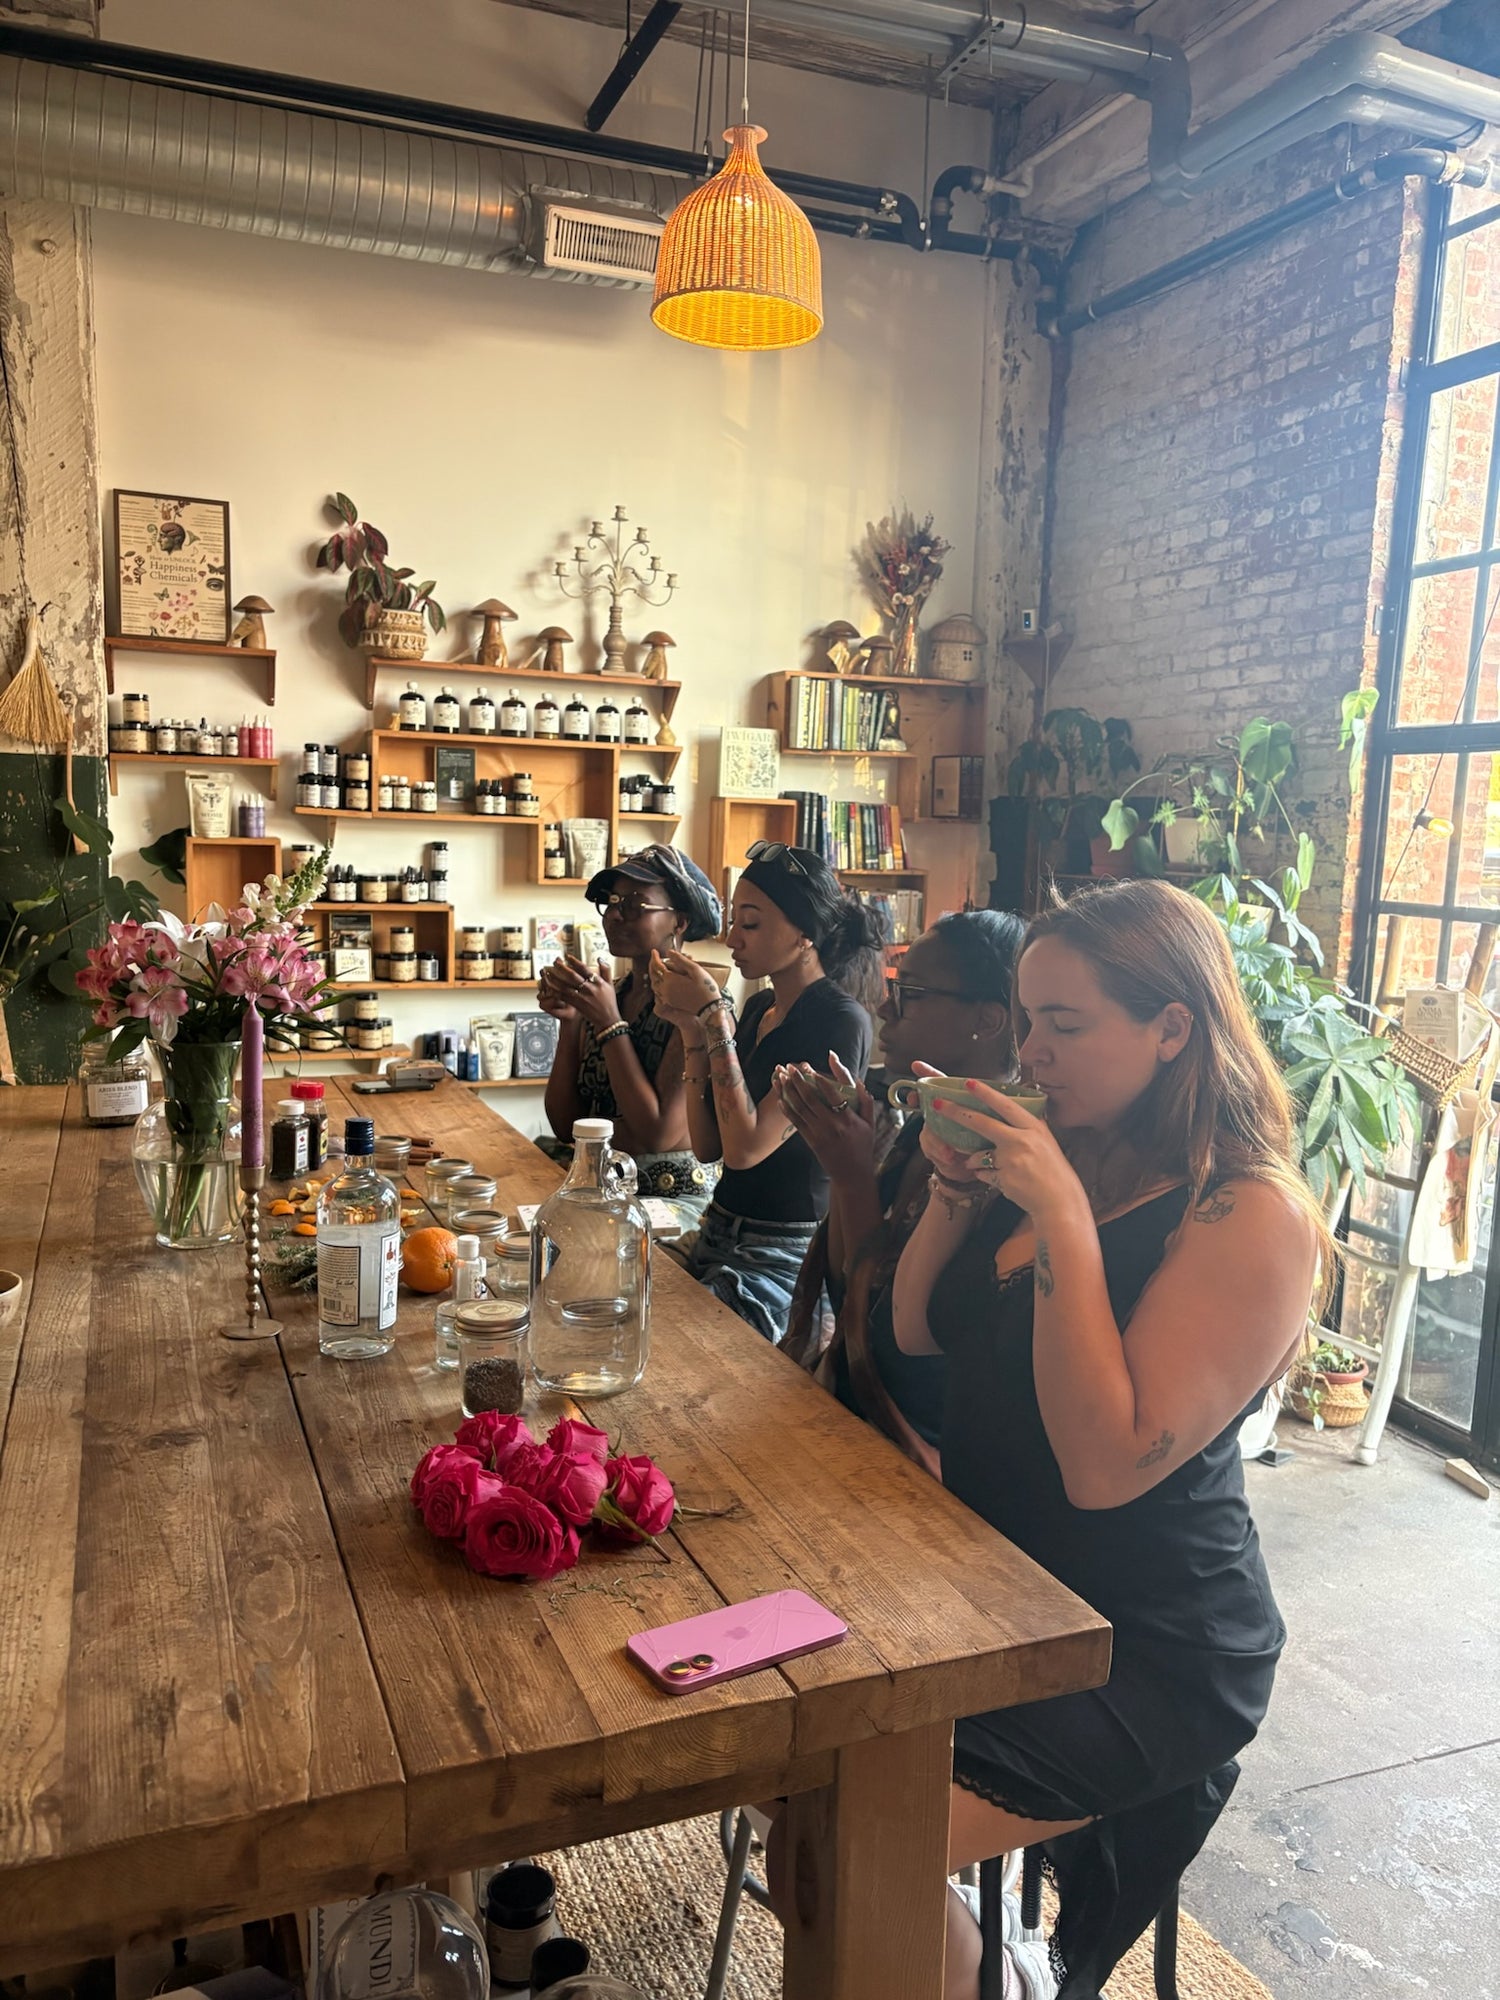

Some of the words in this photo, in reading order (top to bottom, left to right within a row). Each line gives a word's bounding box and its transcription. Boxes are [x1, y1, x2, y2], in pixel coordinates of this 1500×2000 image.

[149, 561, 197, 574] Happiness
[149, 571, 198, 583] Chemicals
[369, 1904, 392, 1990] MUNDI
